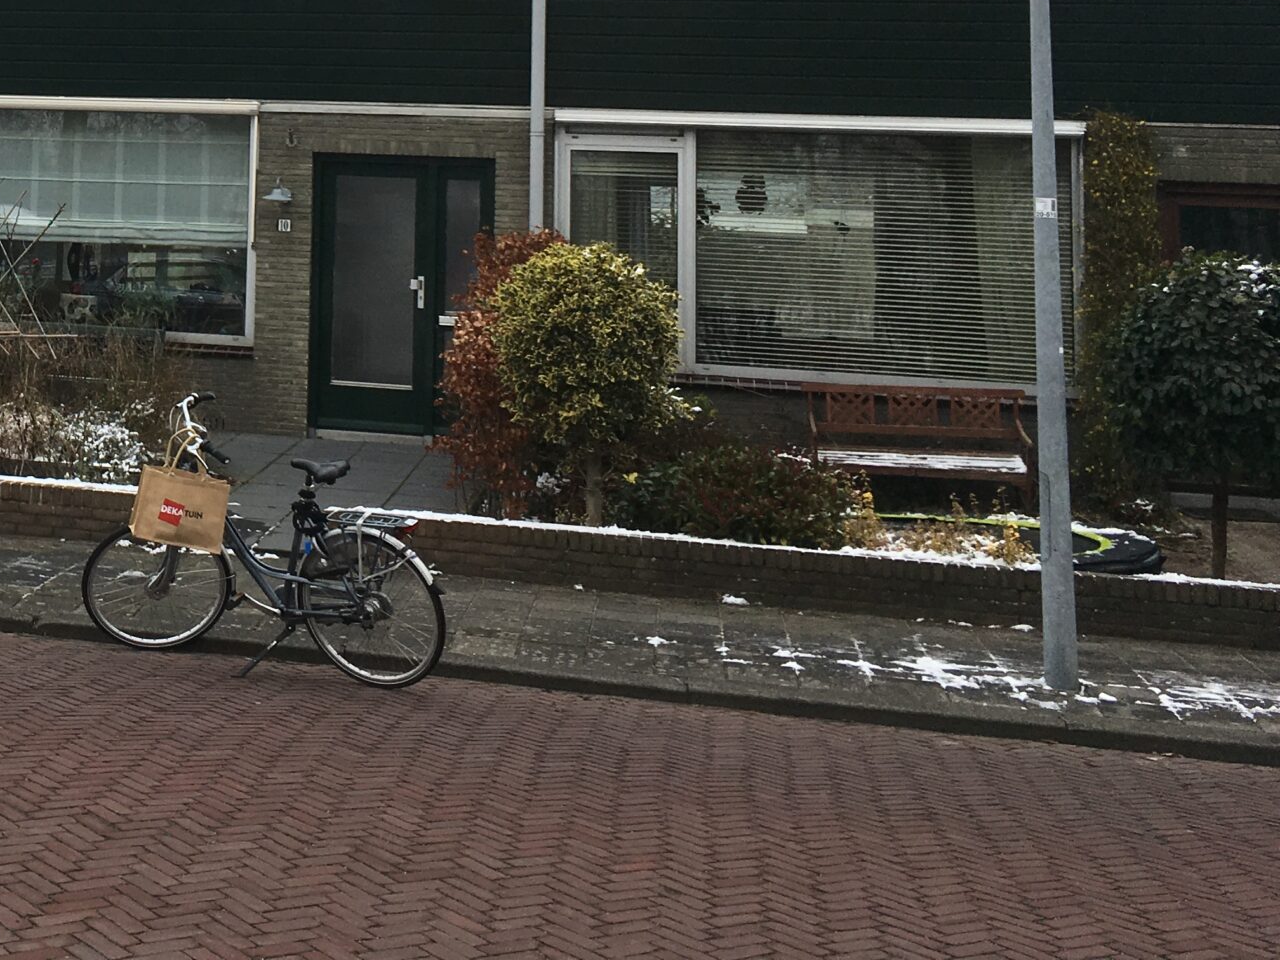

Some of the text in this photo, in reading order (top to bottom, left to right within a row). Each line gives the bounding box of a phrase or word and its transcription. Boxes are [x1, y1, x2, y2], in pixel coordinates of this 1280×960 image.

[280, 220, 289, 231] 10
[160, 504, 203, 519] DEKA TUIN
